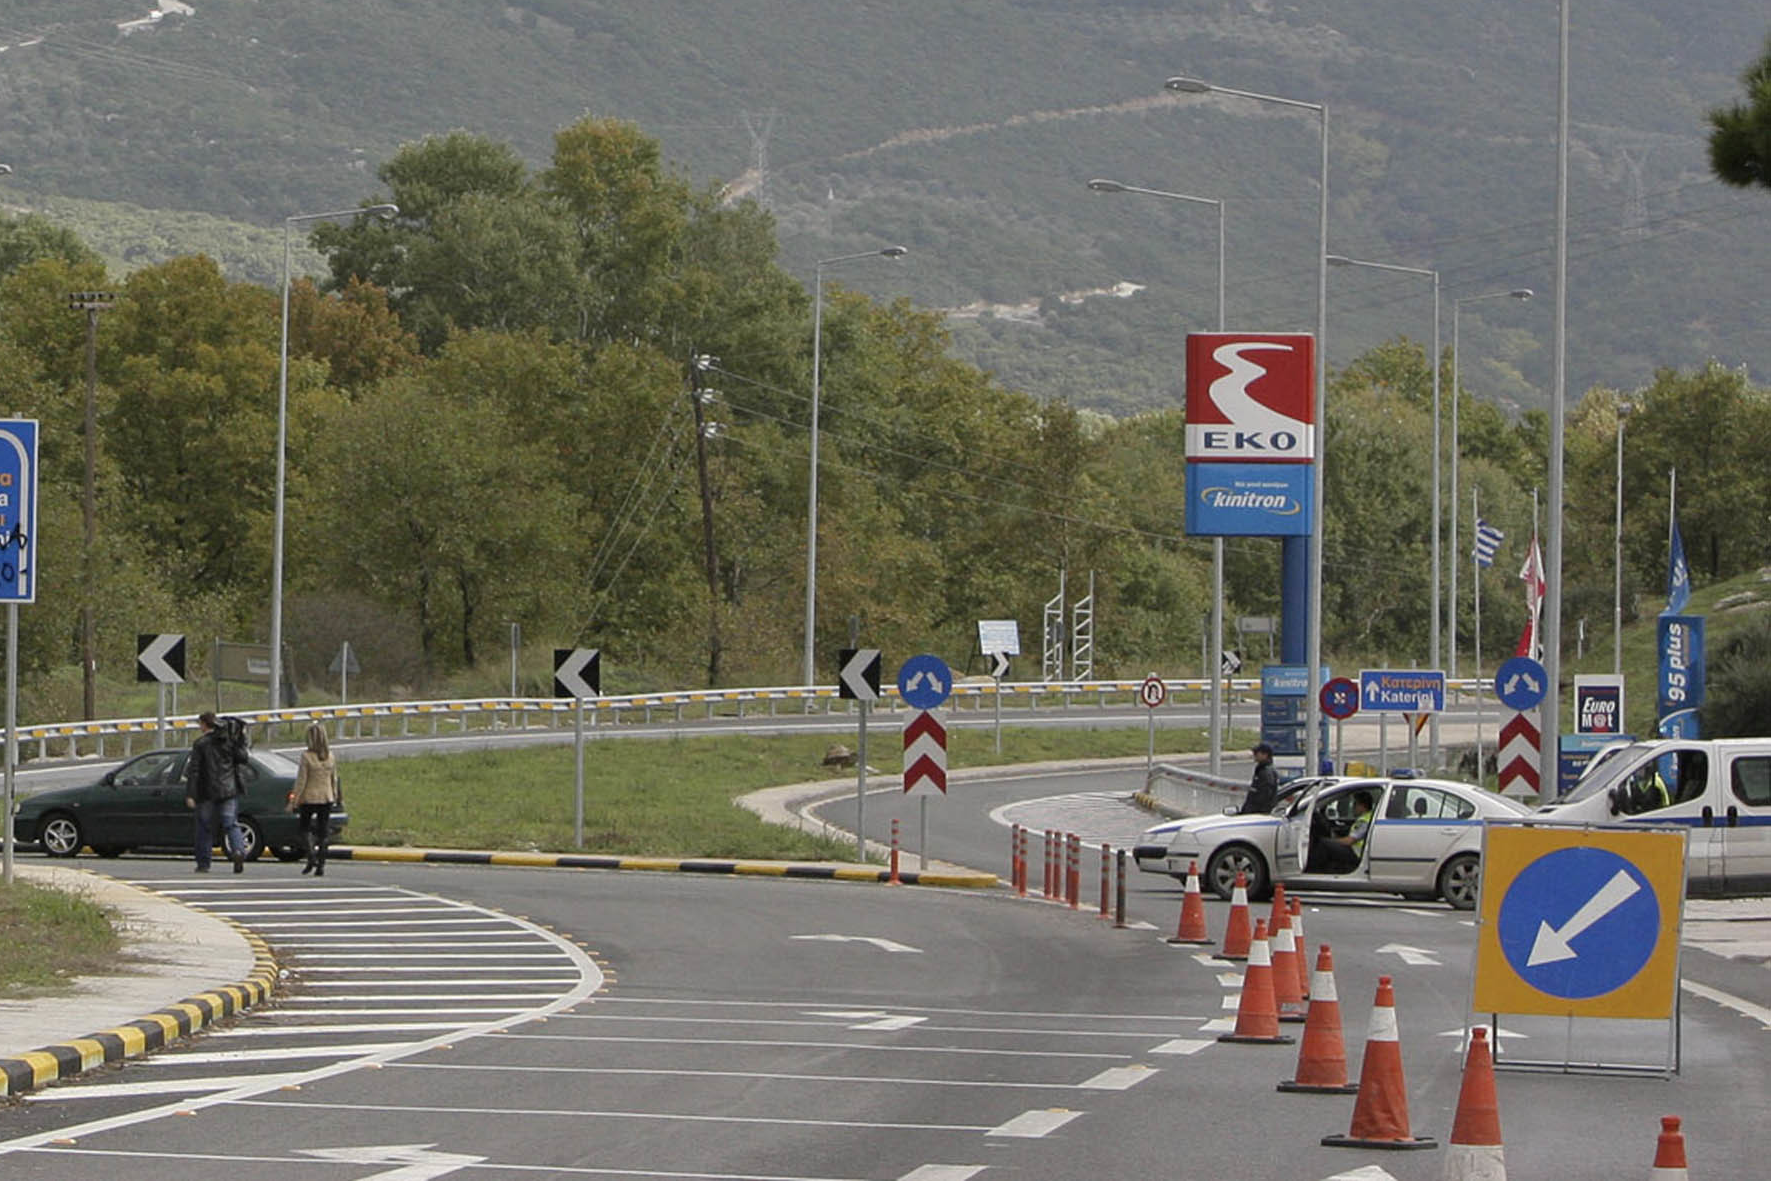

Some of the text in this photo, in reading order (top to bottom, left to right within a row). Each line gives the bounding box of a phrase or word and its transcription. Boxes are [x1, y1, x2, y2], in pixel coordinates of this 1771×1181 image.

[1204, 431, 1297, 450] EKO
[1213, 491, 1286, 508] kinitron
[1667, 623, 1686, 701] 95 plus
